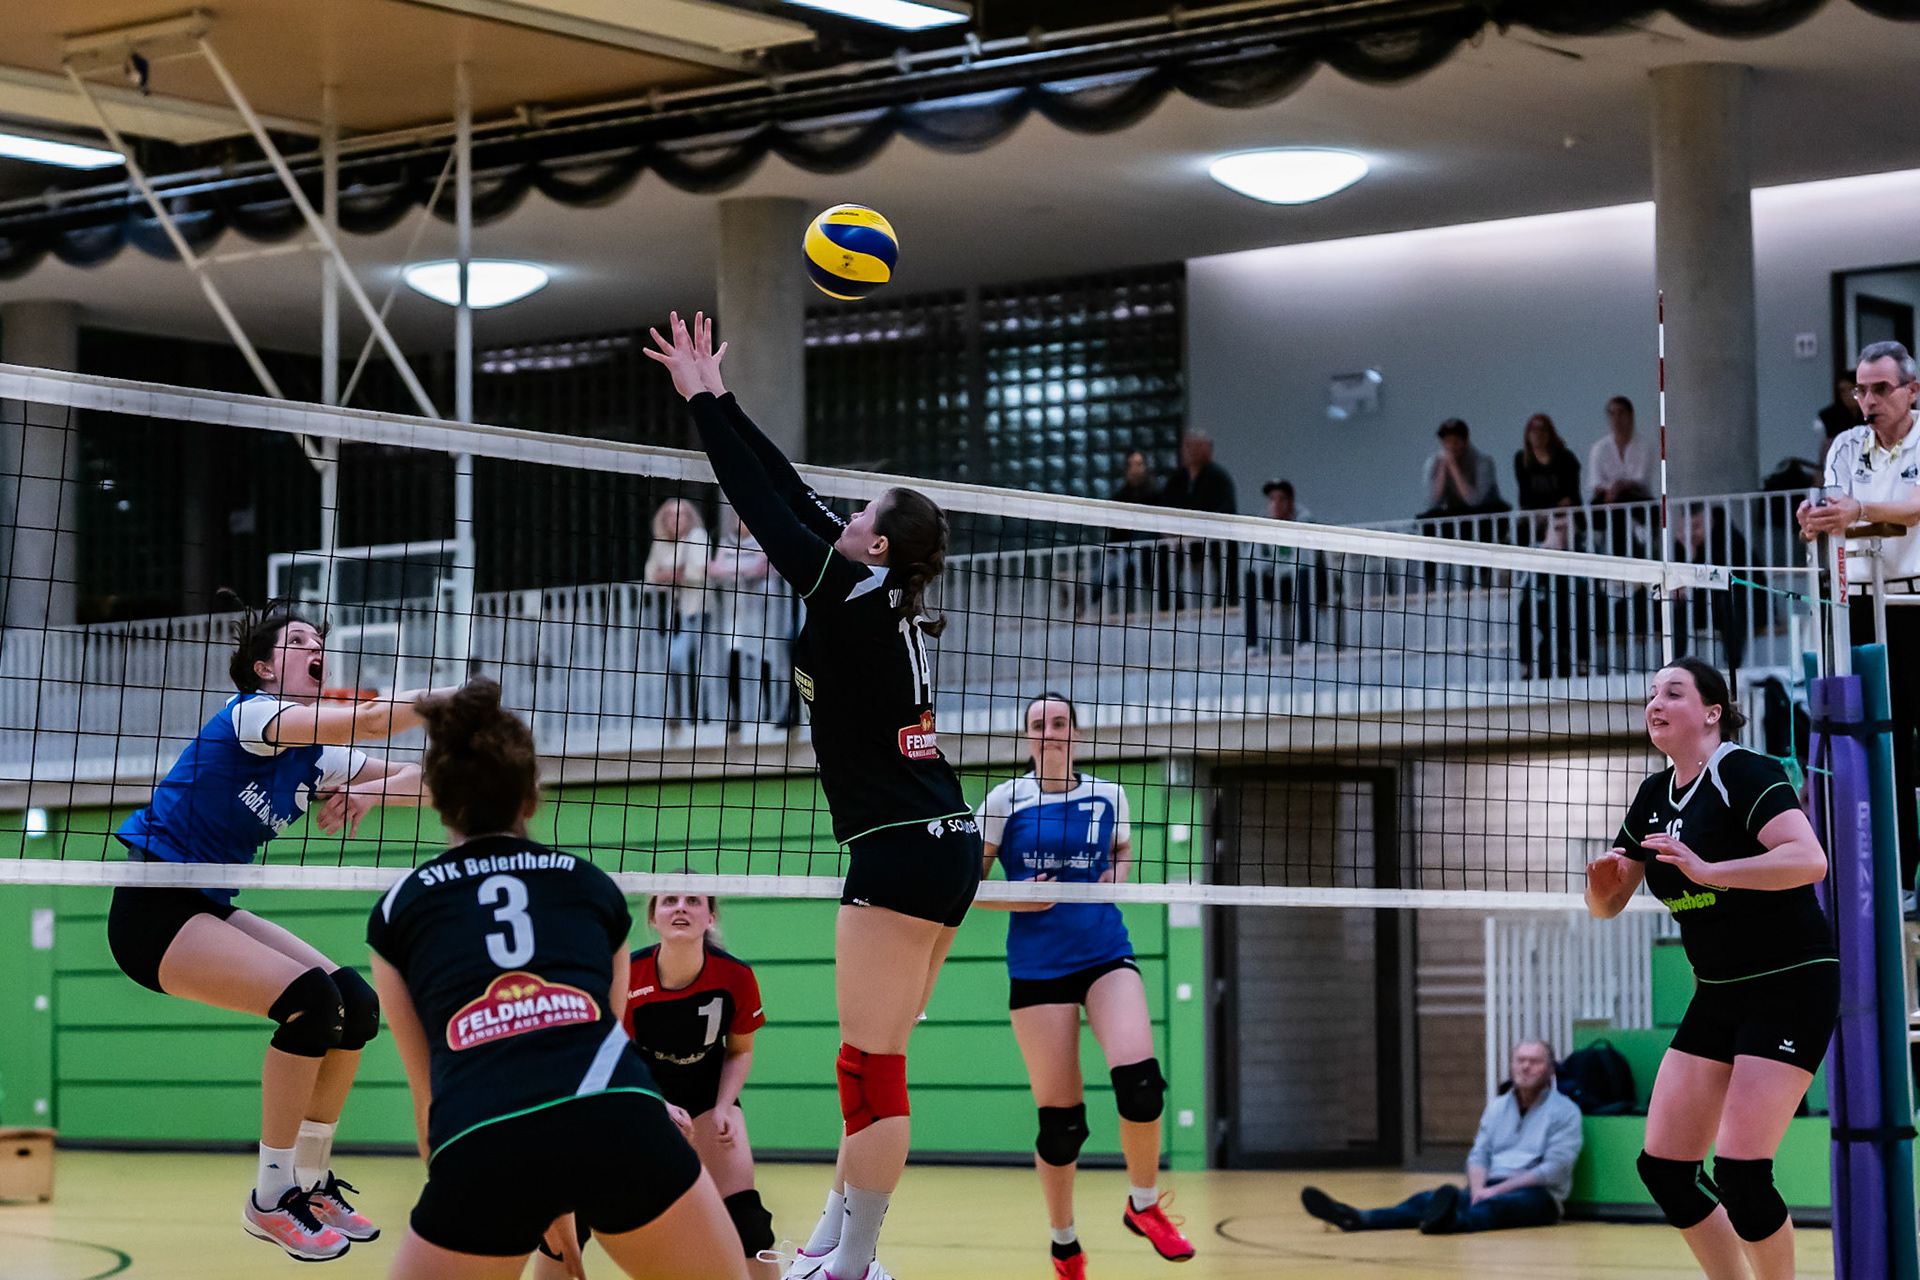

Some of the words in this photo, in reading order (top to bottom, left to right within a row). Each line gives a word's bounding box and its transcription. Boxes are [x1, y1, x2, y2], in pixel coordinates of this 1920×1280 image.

[1837, 547, 1847, 603] BENZ
[237, 780, 267, 813] Holz
[1078, 801, 1106, 844] 7
[418, 863, 462, 887] SVK
[477, 874, 536, 969] 3
[457, 994, 588, 1038] FELDMANN
[513, 1018, 541, 1031] AUS
[544, 1010, 590, 1024] BADEN
[698, 997, 724, 1047] 1
